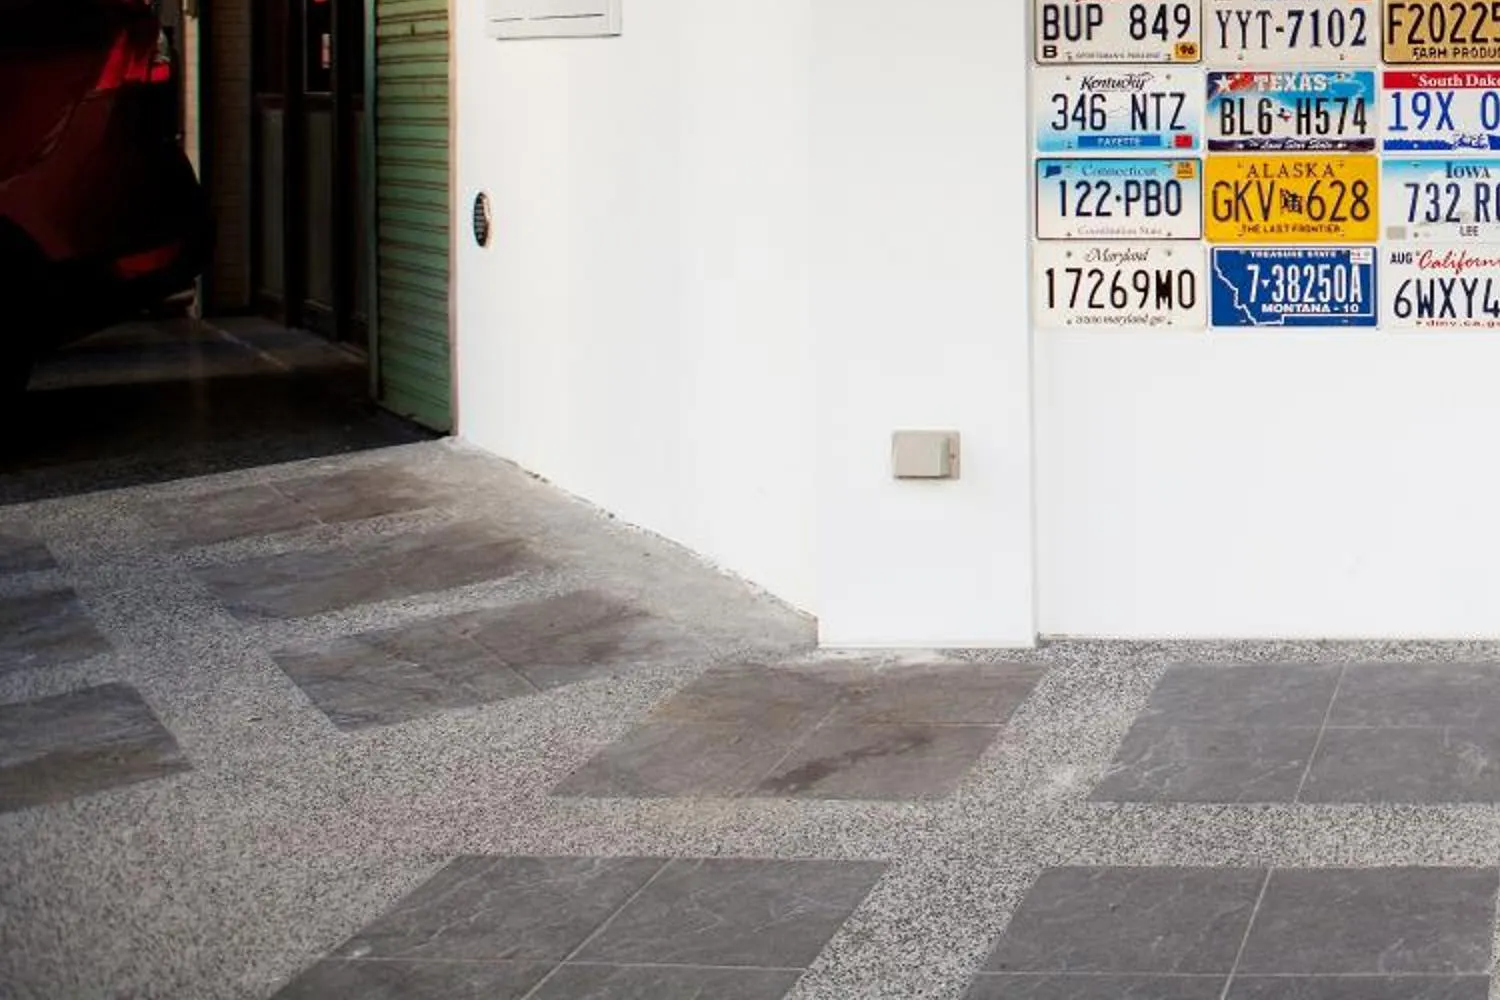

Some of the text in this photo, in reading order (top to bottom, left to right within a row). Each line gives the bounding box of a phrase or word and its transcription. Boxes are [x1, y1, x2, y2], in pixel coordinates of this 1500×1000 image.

[1043, 3, 1192, 41] BUP 849
[1042, 45, 1058, 58] B
[1413, 48, 1448, 59] FARM
[1080, 72, 1154, 91] Kentucky
[1254, 73, 1327, 91] TEXAS
[1417, 74, 1463, 88] South
[1051, 92, 1187, 131] 346 NTZ
[1220, 97, 1367, 136] BL6 H574
[1388, 91, 1454, 131] 19X
[1082, 165, 1156, 177] Connecticut
[1245, 164, 1336, 179] ALASKA
[1212, 179, 1370, 222] GKV 628
[1404, 183, 1461, 223] 732
[1460, 225, 1479, 236] LEE
[1390, 253, 1413, 265] AUG
[1261, 303, 1359, 313] MONTANA 10
